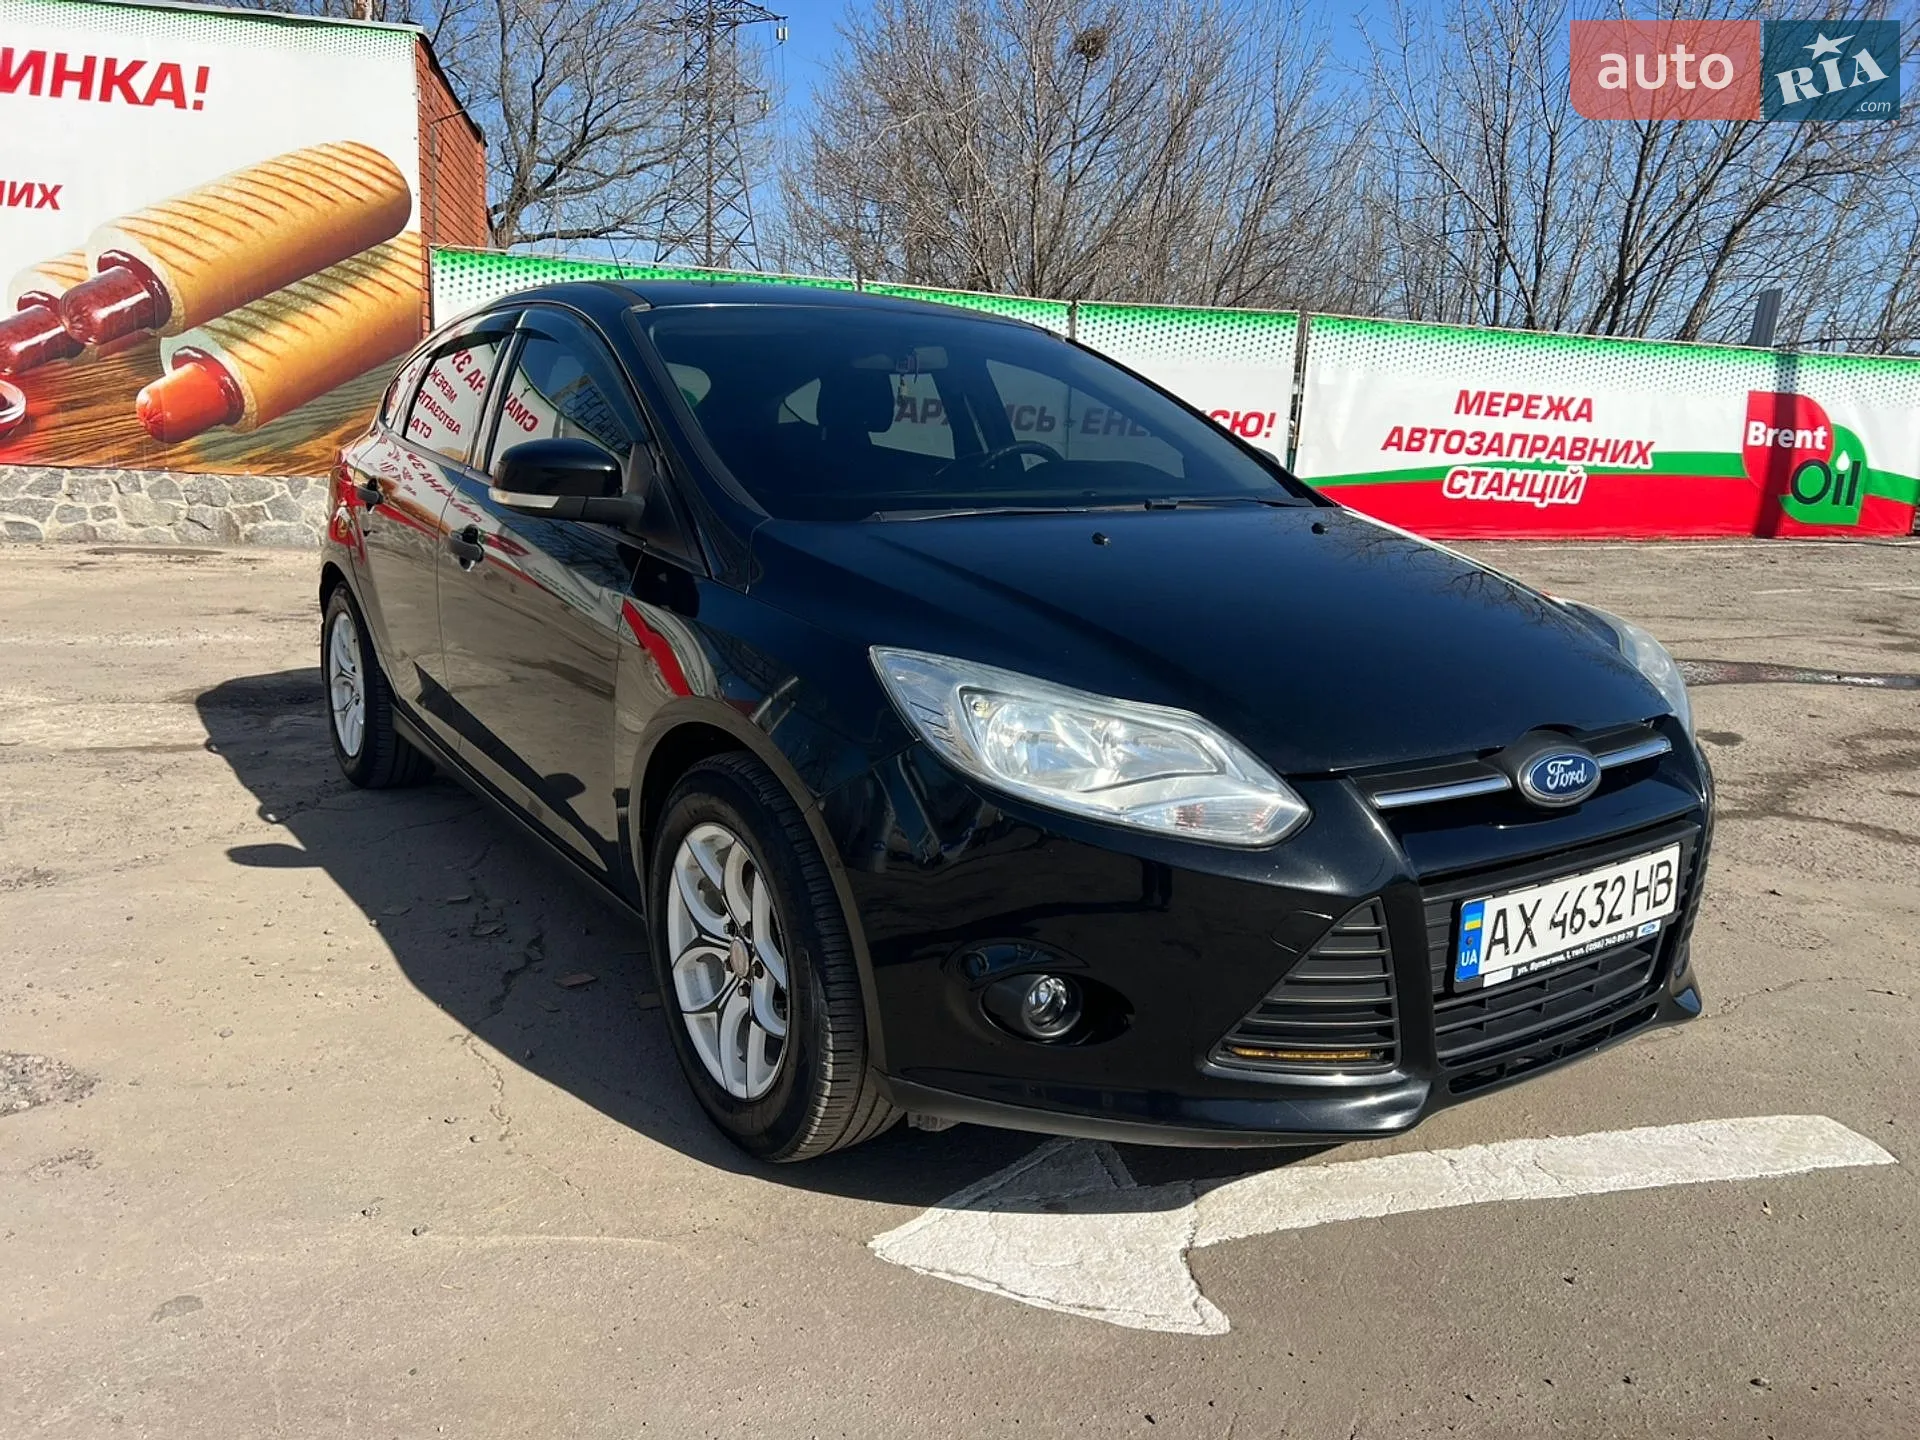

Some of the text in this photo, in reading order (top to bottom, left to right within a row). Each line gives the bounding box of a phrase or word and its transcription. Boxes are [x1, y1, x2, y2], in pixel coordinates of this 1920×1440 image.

[1454, 389, 1593, 423] МЕРЕЖА
[1382, 427, 1654, 465] АВТОЗАПРАВНИХ
[1748, 420, 1826, 450] Brent
[1446, 468, 1584, 503] СТАНЦІЙ
[1790, 458, 1861, 507] Oil
[1546, 759, 1587, 790] Ford
[1484, 860, 1673, 961] AX 4632 HB
[1461, 949, 1477, 966] UA
